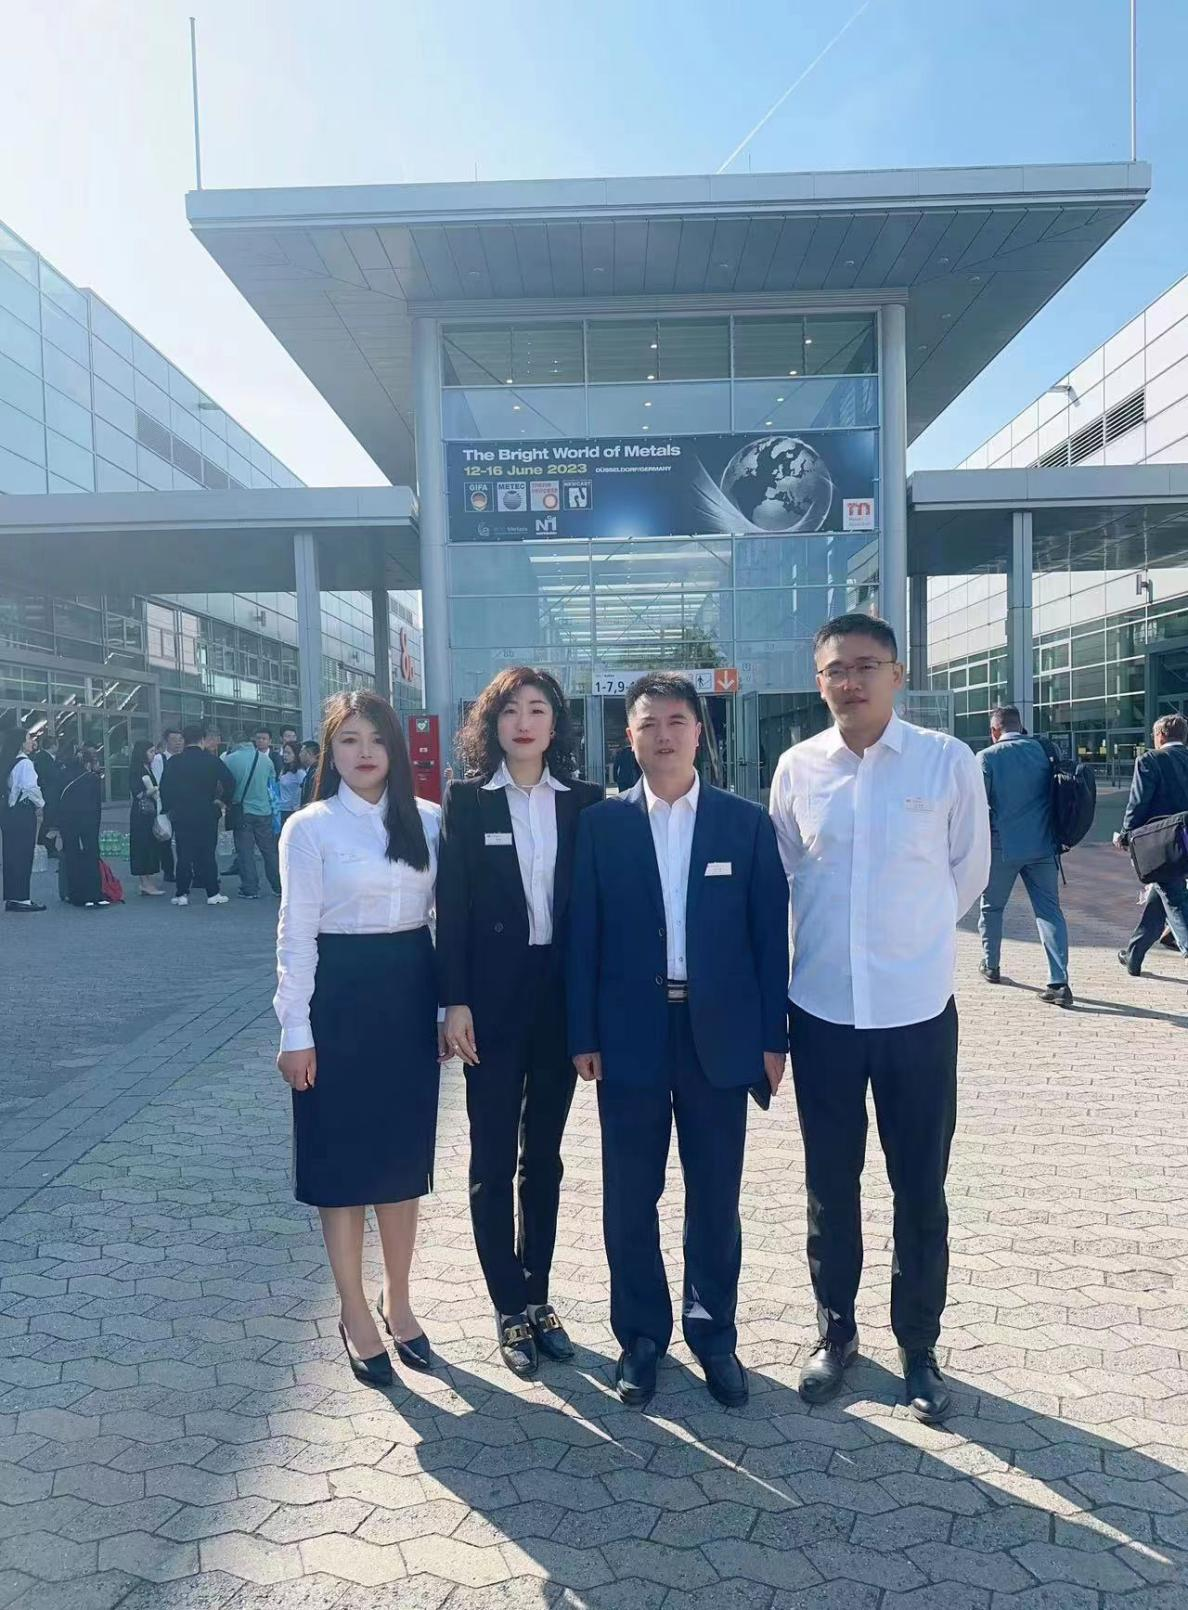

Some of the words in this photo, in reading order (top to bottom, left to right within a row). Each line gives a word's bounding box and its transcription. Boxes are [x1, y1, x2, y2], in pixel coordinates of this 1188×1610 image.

[462, 449, 495, 461] The
[499, 448, 549, 463] Bright
[553, 446, 600, 459] World
[603, 446, 621, 458] of
[624, 444, 681, 457] Metals
[464, 466, 503, 476] 12-16
[507, 465, 543, 475] June
[547, 463, 588, 474] 2023
[469, 484, 488, 492] GIFA
[498, 482, 526, 491] METEC
